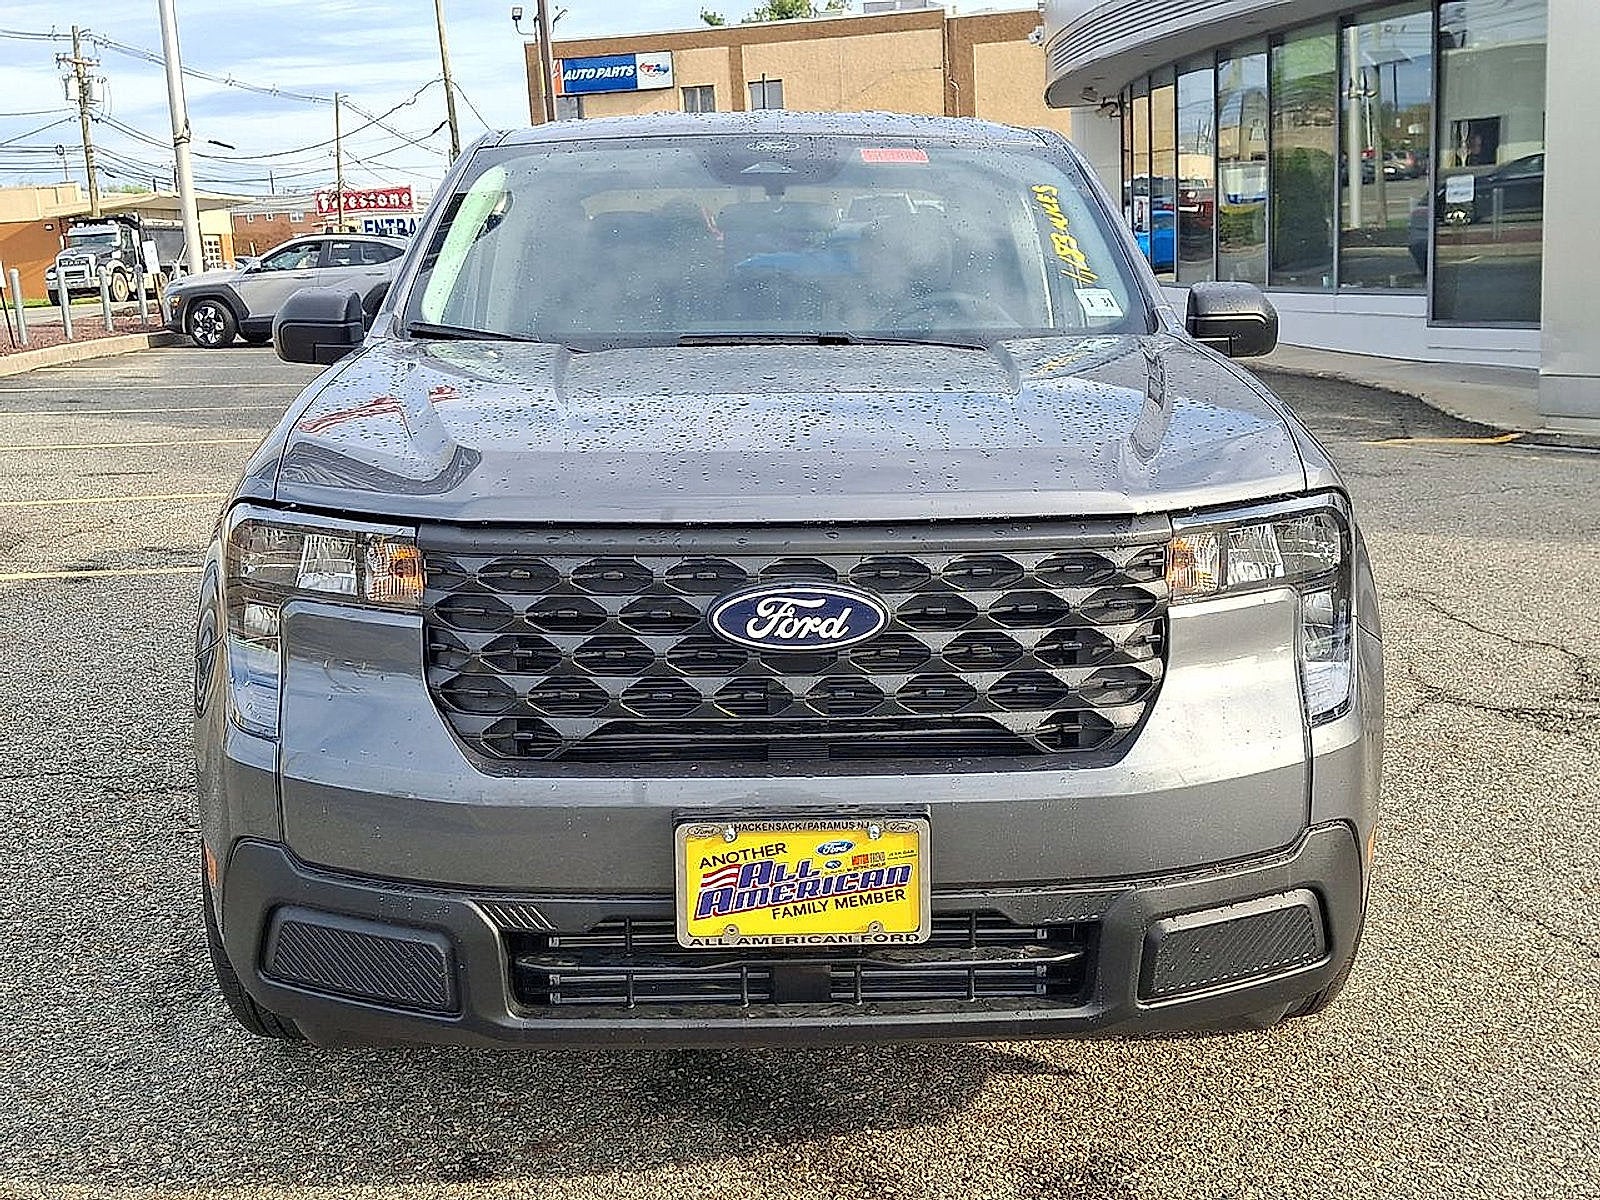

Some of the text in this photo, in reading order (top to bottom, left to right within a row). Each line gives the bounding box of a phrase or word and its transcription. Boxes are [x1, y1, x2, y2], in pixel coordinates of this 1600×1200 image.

[564, 67, 596, 81] AUTO
[596, 64, 635, 79] PARTS
[746, 597, 852, 639] Ford
[700, 843, 787, 869] ANOTHER
[772, 889, 906, 920] FAMILY MEMBER
[689, 934, 920, 947] ALL AMERICAN FORD
